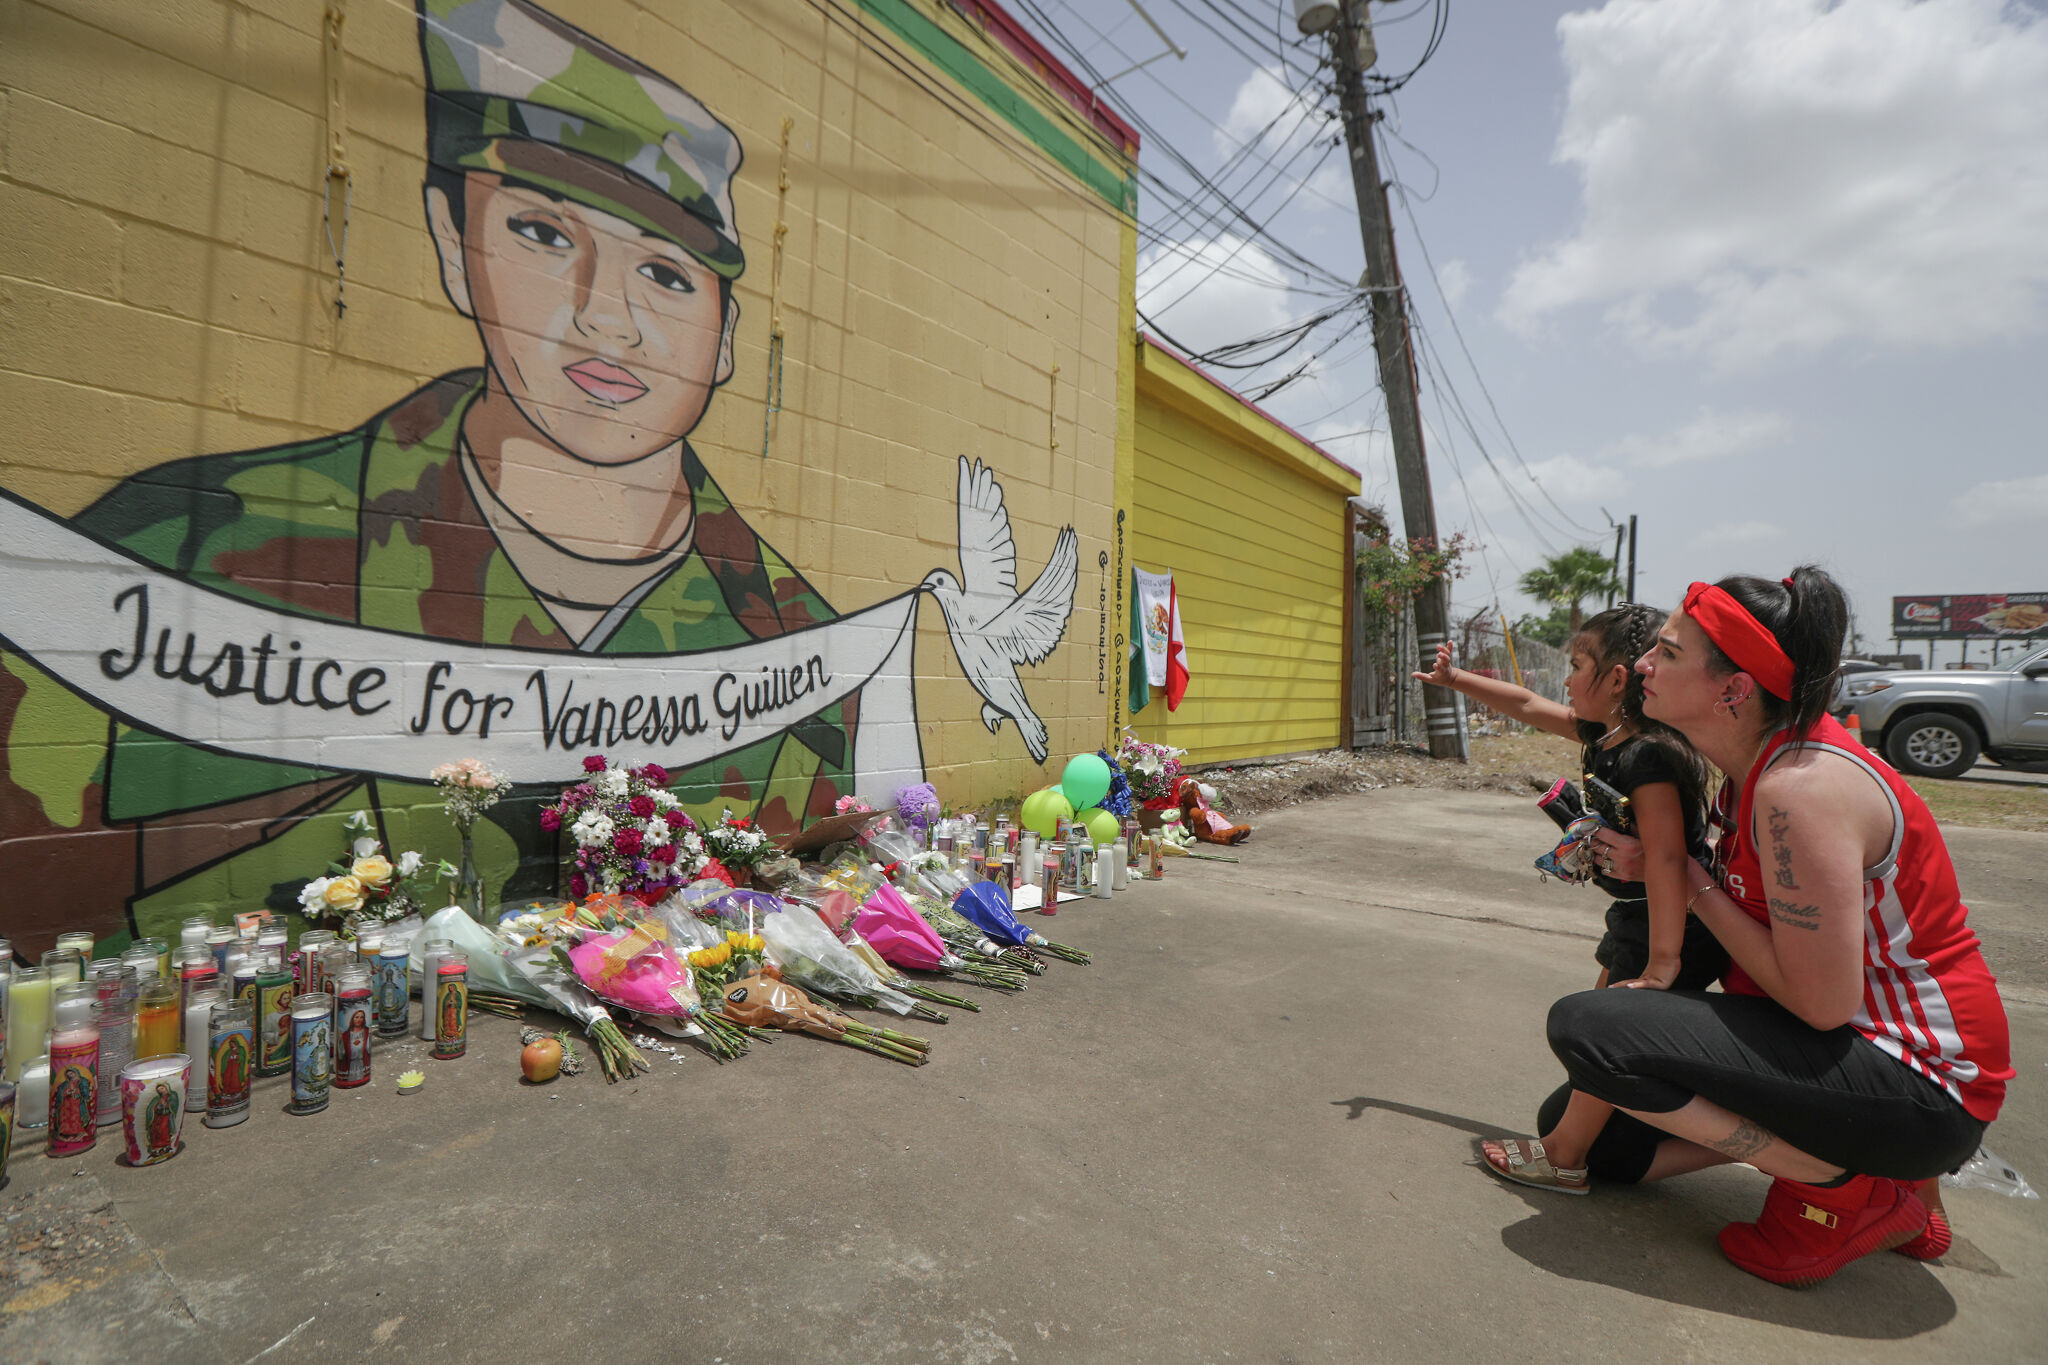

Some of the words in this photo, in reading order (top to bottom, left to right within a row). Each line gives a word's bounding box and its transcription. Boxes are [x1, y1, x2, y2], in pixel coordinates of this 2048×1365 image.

[99, 582, 391, 716] Justice
[410, 660, 514, 739] for
[525, 669, 708, 751] Vanessa
[712, 654, 832, 741] Guillen
